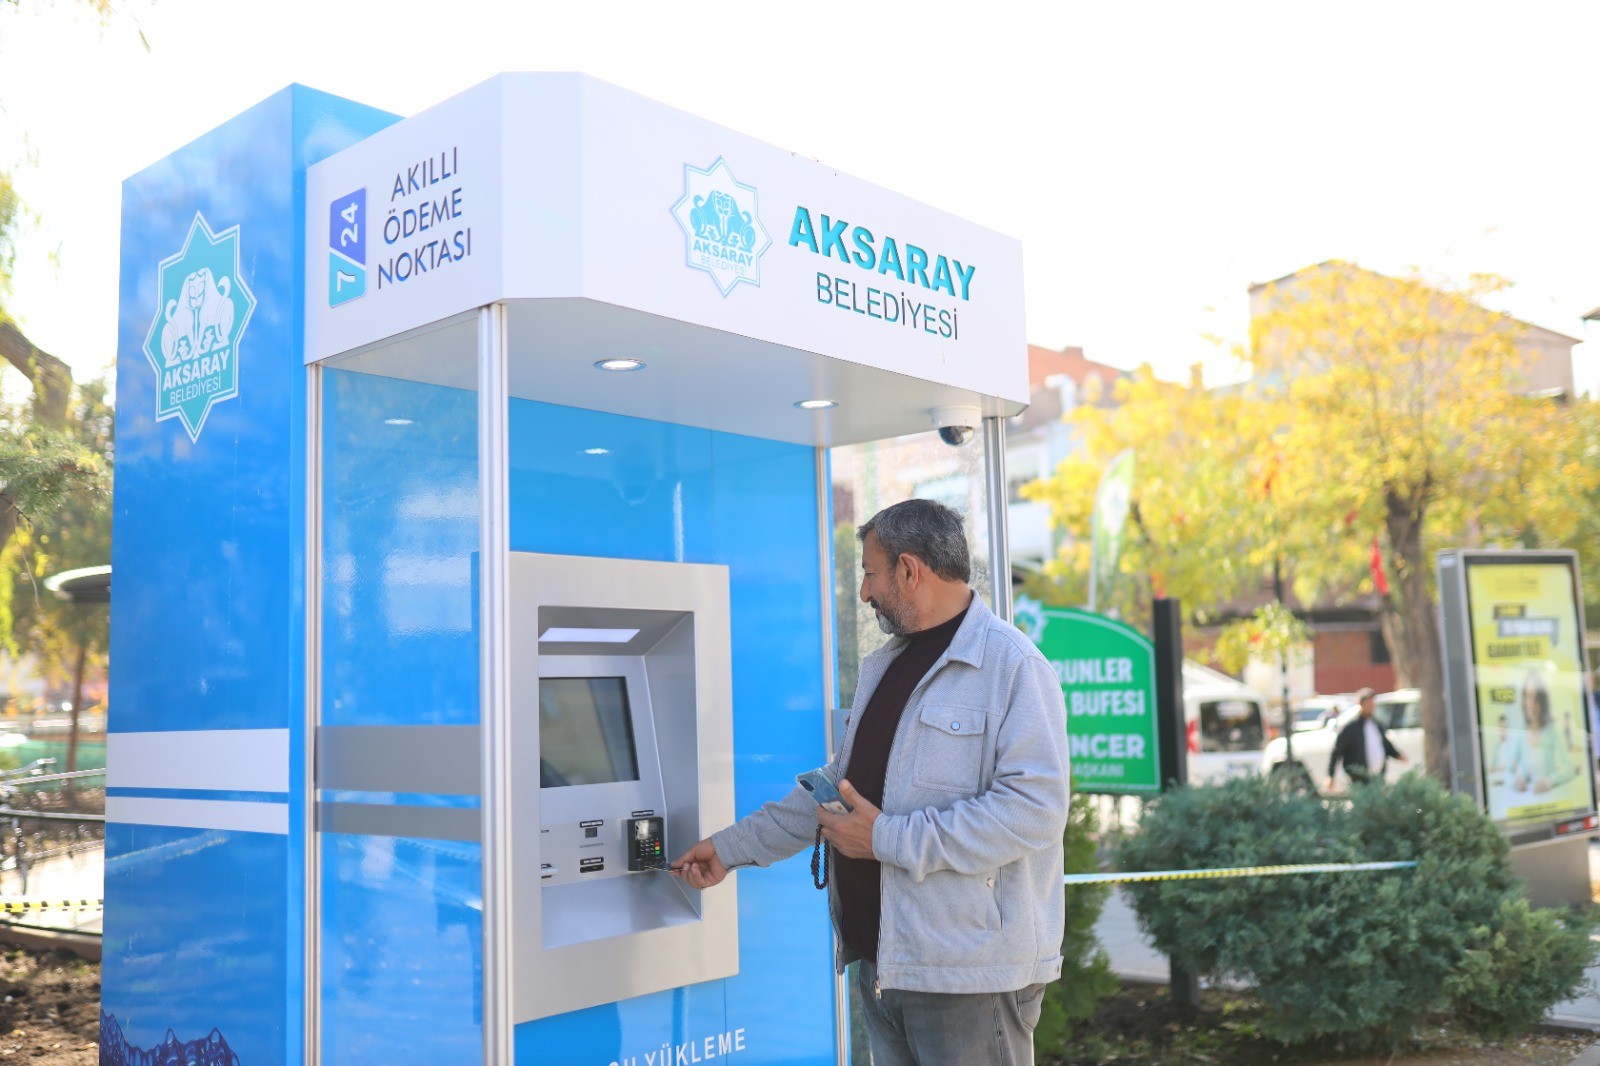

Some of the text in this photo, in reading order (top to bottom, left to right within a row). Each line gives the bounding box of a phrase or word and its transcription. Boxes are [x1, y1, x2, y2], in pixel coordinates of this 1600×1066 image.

[391, 146, 457, 203] AKILLI
[383, 187, 462, 245] ÖDEME
[378, 227, 471, 290] NOKTASI
[693, 239, 754, 267] AKSARAY
[788, 205, 976, 301] AKSARAY
[816, 271, 958, 340] BELEDİYESİ
[162, 348, 230, 392] AKSARAY
[169, 372, 221, 406] BELEDİYESİ
[644, 1027, 746, 1066] YÜKLEME
